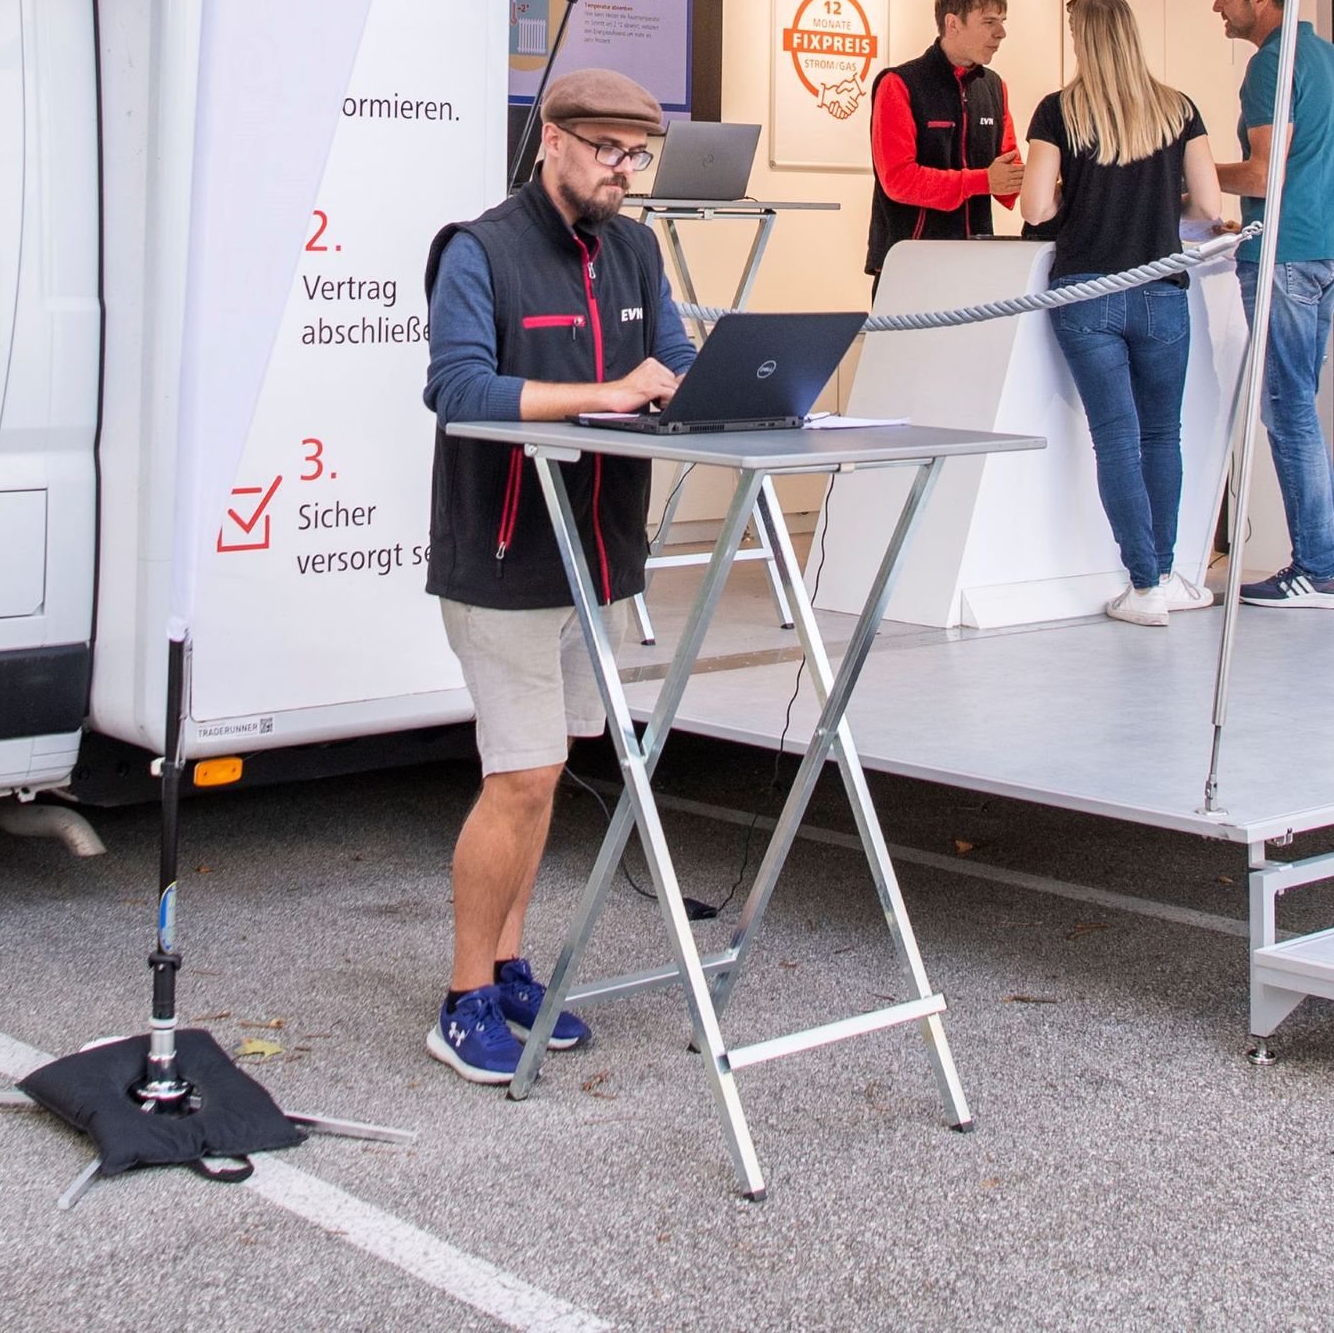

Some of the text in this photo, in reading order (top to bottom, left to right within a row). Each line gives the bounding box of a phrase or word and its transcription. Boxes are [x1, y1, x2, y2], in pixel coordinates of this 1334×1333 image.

[823, 0, 843, 16] 12
[813, 18, 852, 31] MONATE
[792, 32, 871, 55] FIXPREIS
[305, 209, 342, 252] 2.
[302, 275, 397, 308] Vertrag
[300, 438, 338, 481] 3.
[298, 500, 377, 530] Sicher
[296, 543, 403, 576] versorgt
[198, 723, 258, 738] TRADERUNNER
